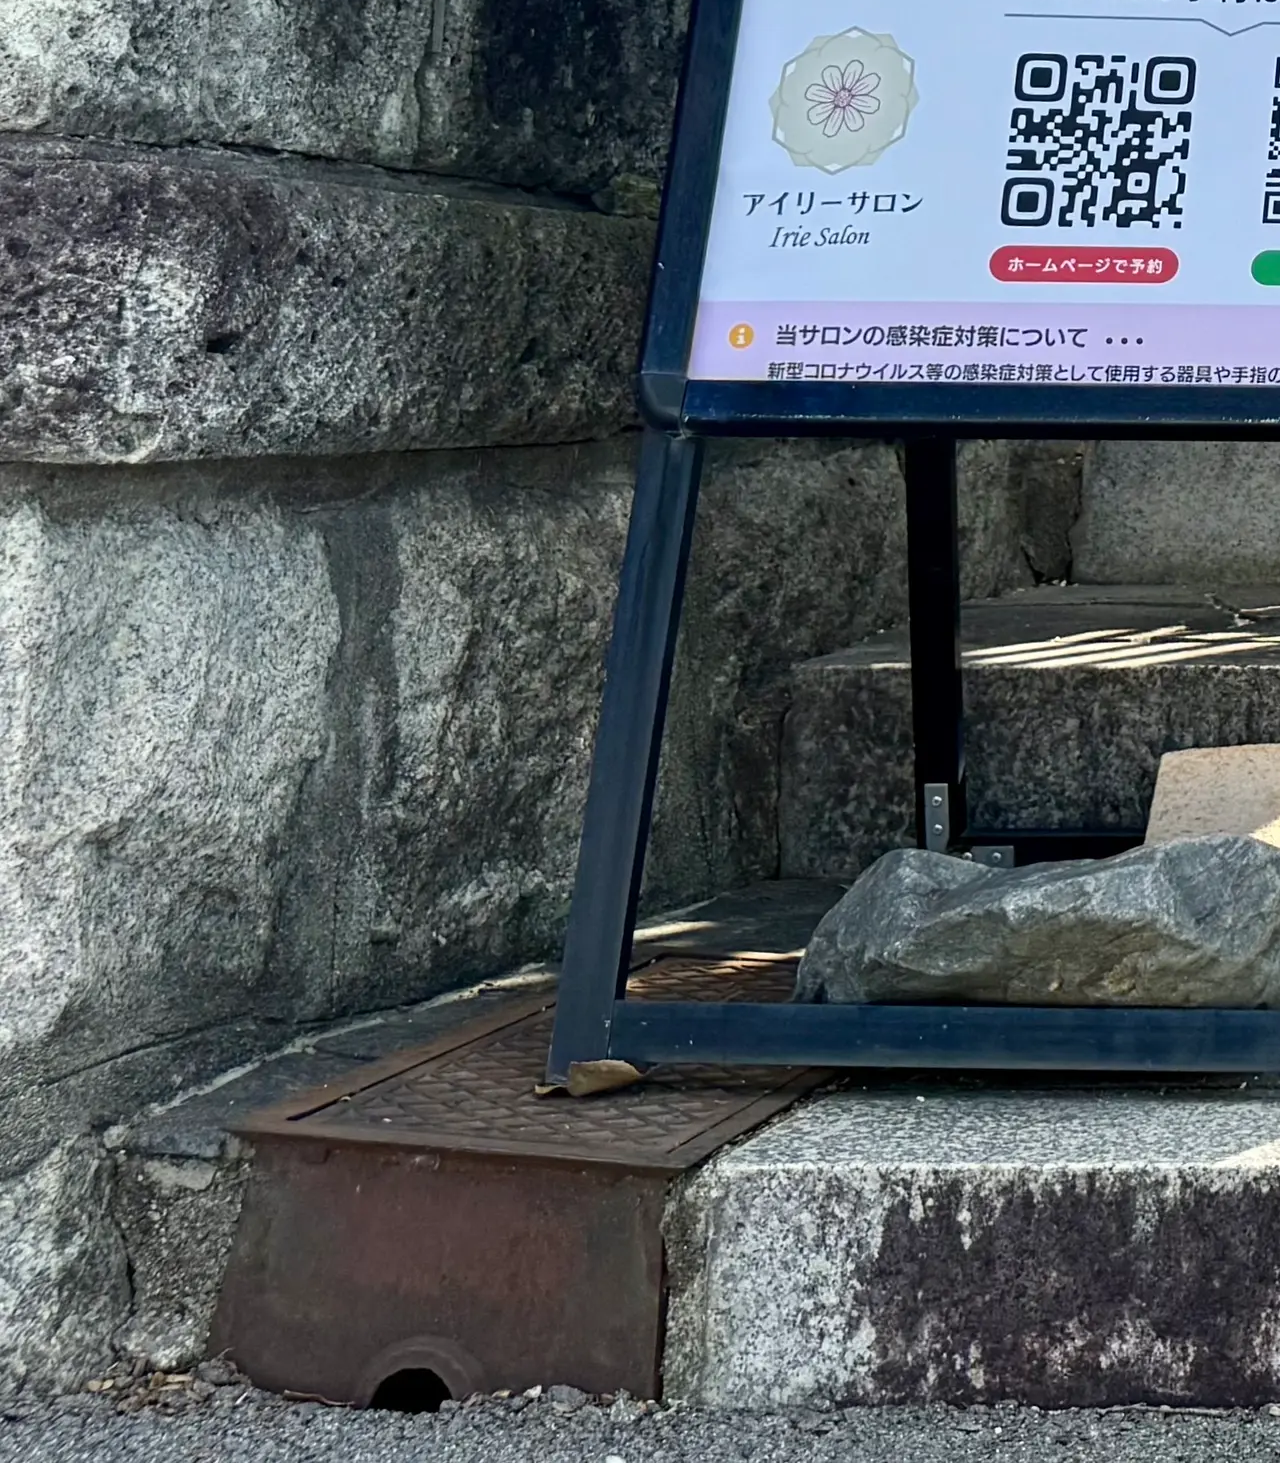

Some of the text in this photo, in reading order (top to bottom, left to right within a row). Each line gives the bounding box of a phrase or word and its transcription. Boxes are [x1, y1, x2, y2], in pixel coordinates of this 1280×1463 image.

[742, 192, 924, 216] アイリーサロン
[769, 226, 870, 249] Irie Salon
[1007, 255, 1164, 276] ホームページで予約
